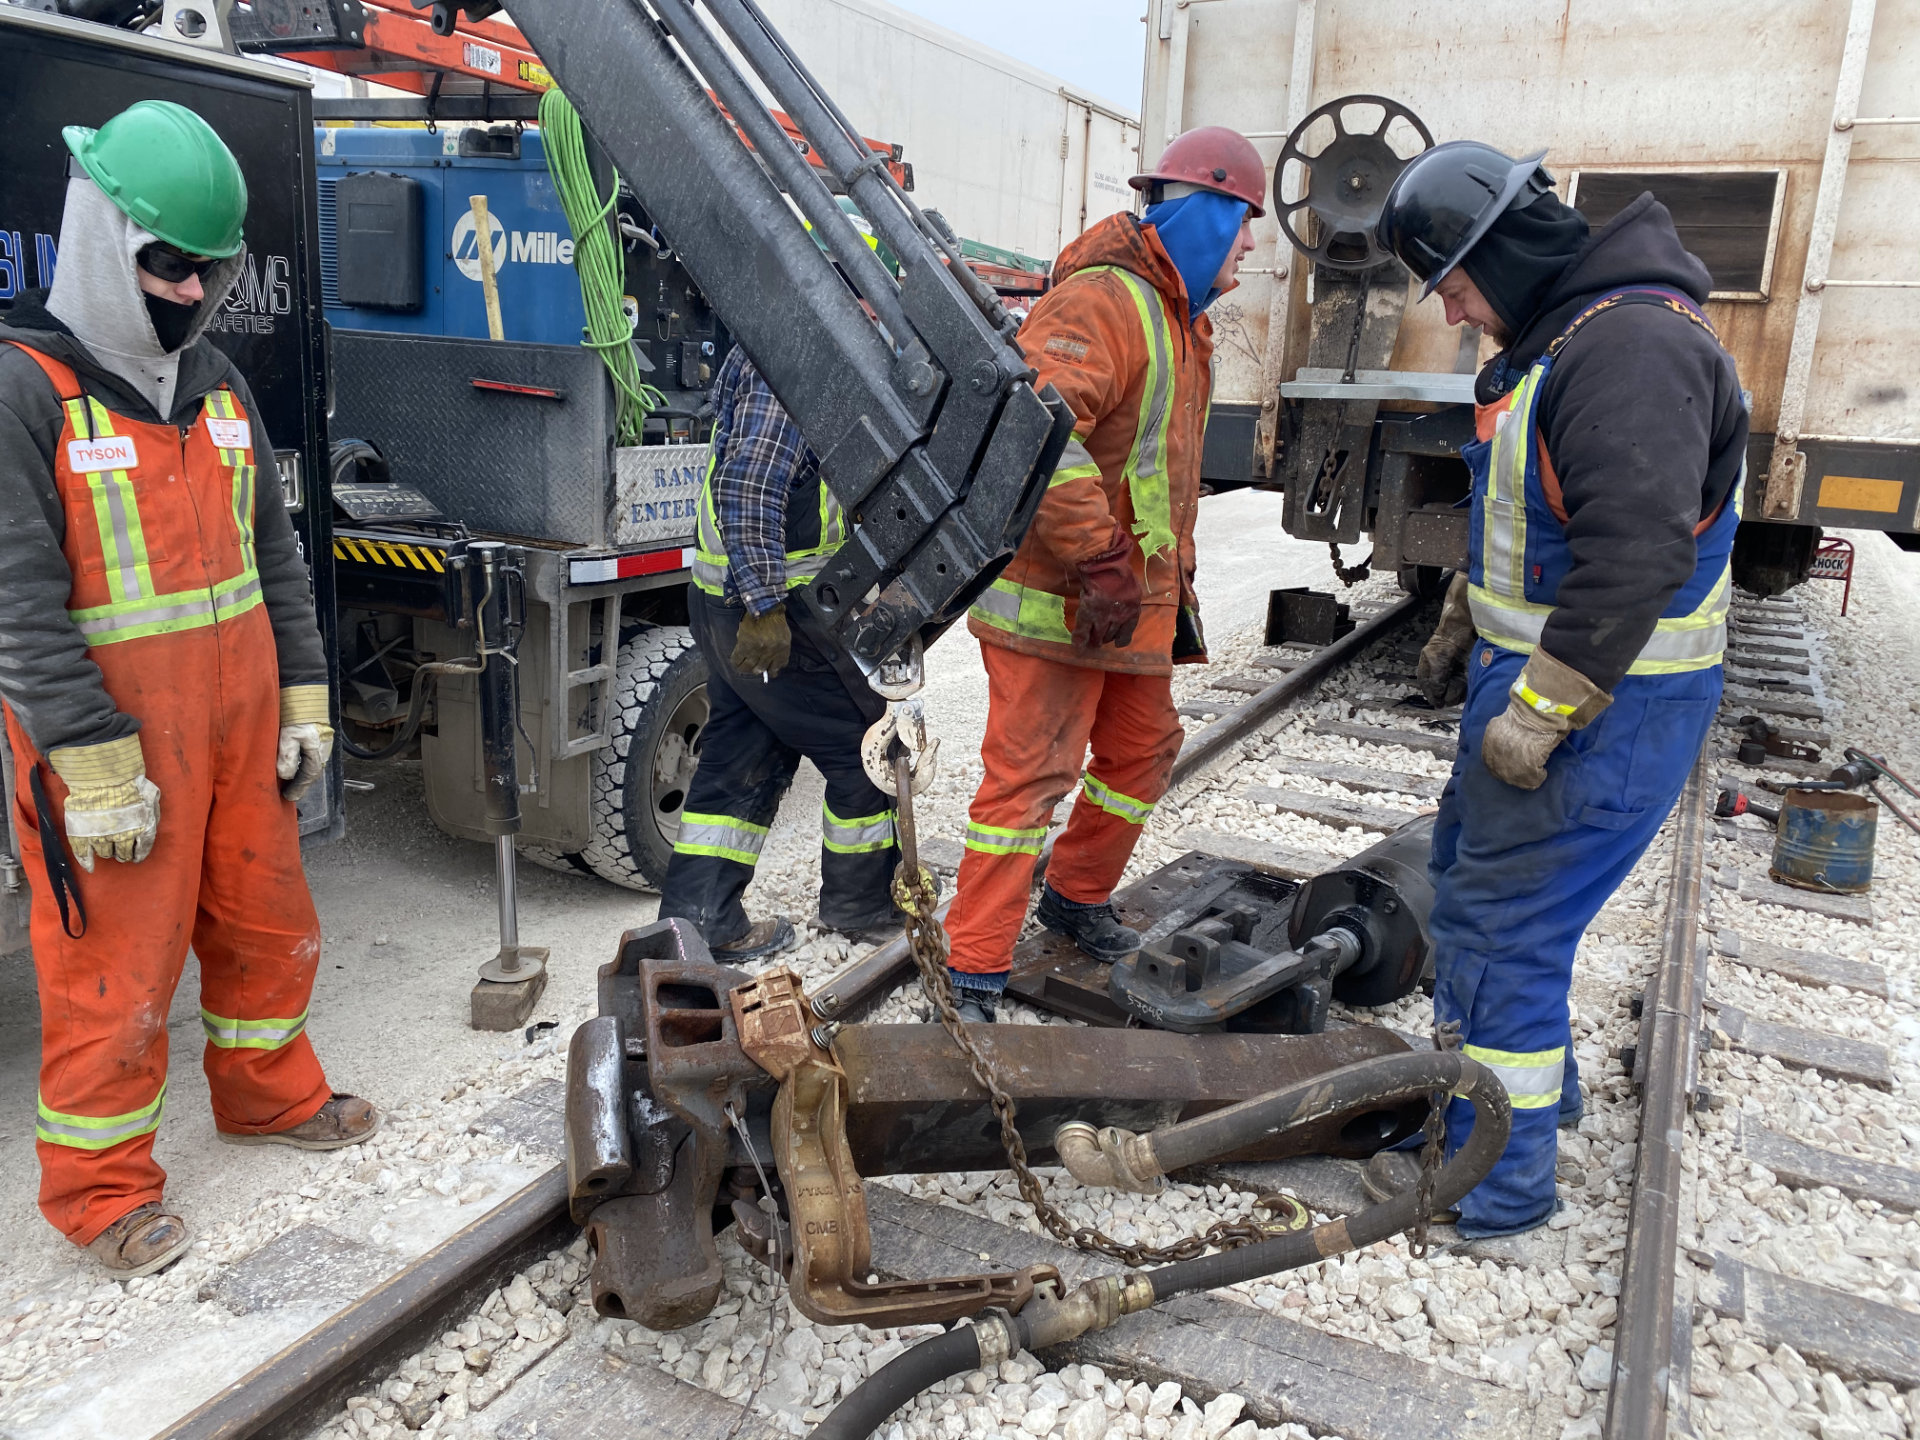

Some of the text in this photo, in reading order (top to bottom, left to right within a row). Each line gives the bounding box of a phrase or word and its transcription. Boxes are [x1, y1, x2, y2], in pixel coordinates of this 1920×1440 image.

[205, 313, 275, 334] AFETIES
[76, 447, 127, 462] TYSON
[632, 498, 697, 524] ENTER
